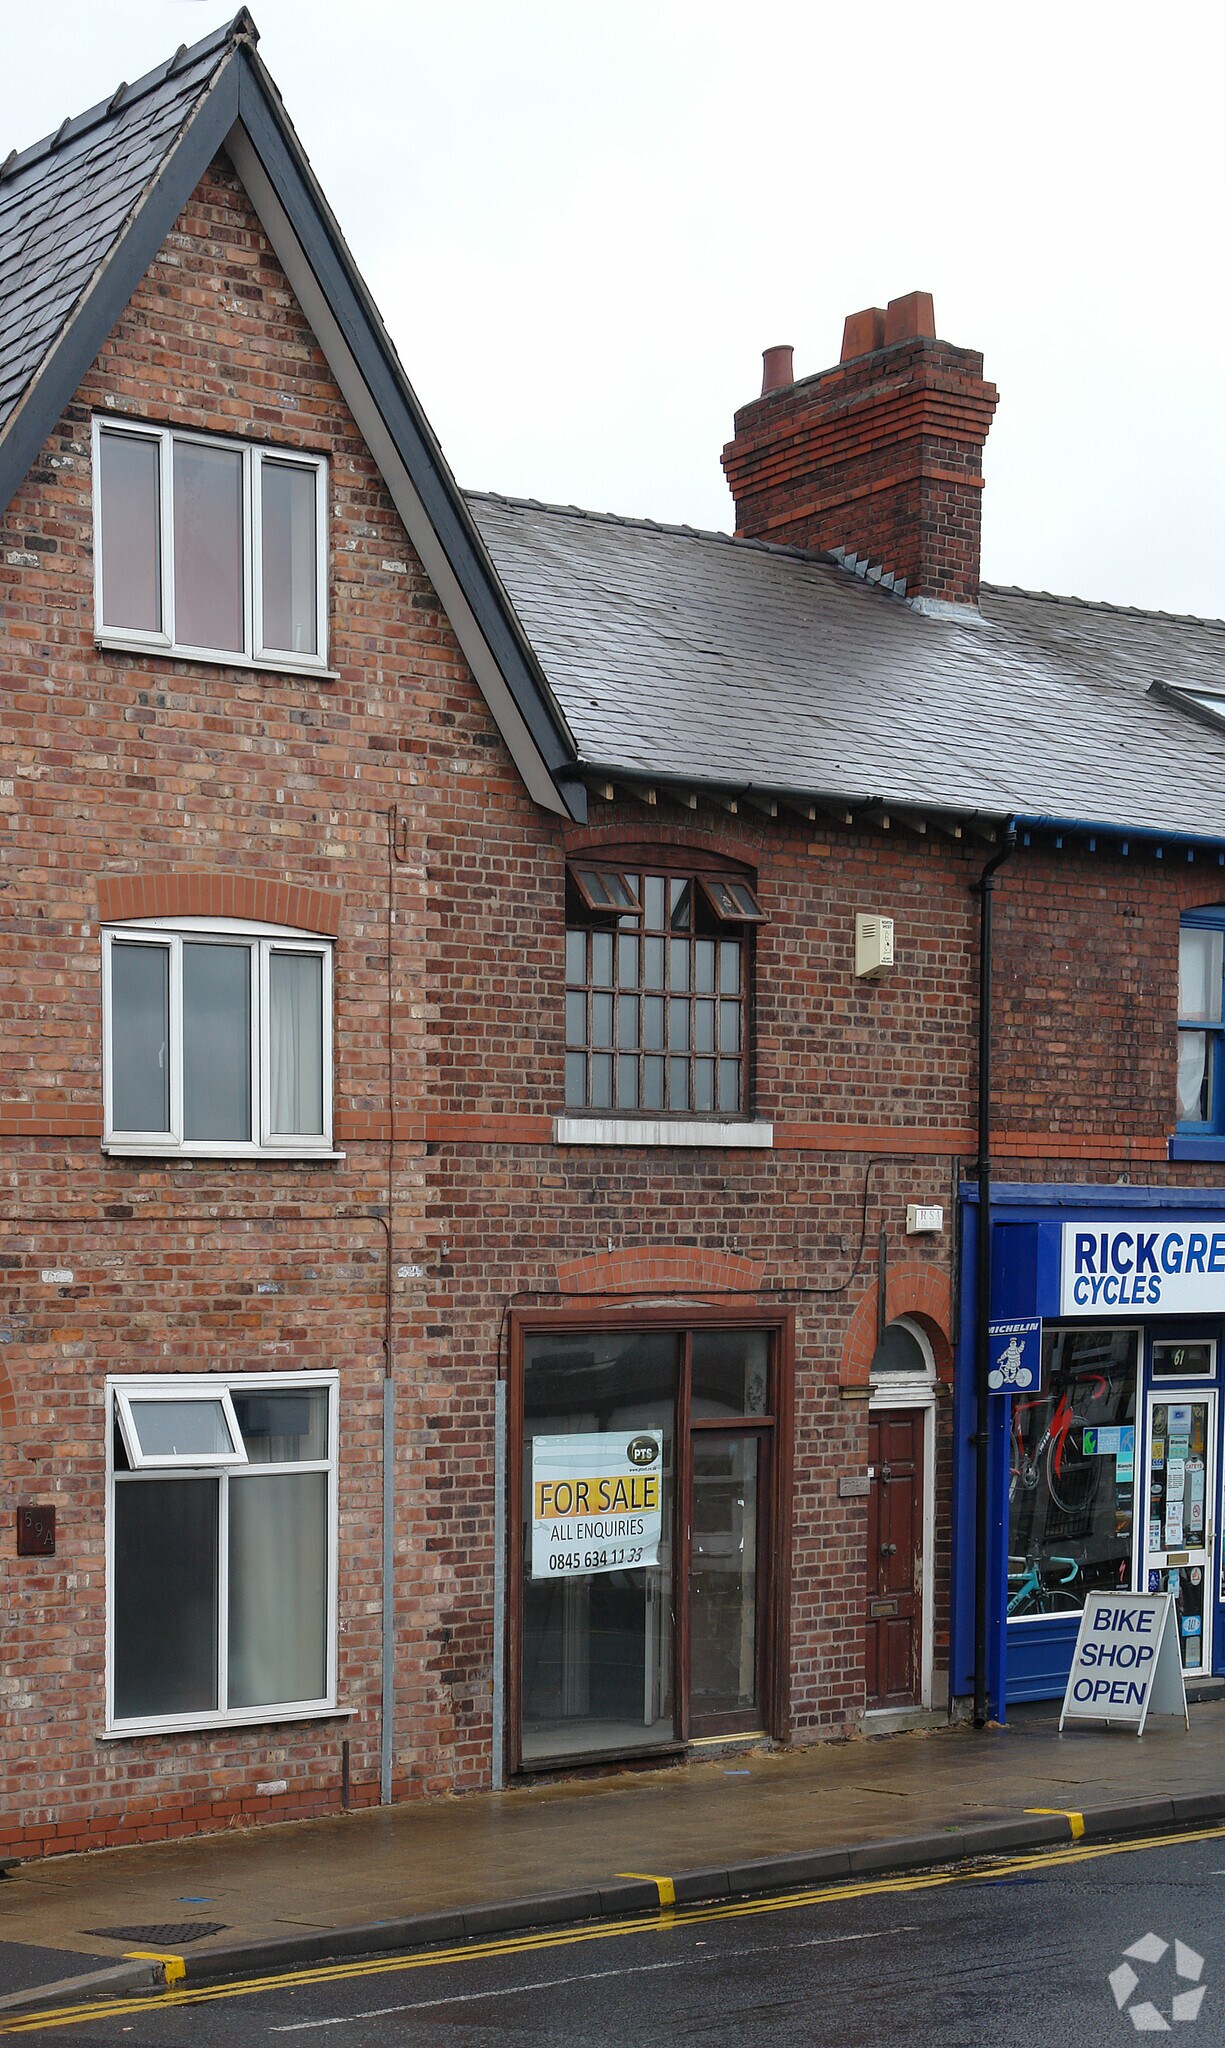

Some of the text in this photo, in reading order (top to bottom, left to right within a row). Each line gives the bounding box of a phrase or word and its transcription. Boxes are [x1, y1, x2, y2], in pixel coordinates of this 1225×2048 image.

[1074, 1275, 1162, 1306] CYCLES
[988, 1322, 1039, 1334] MICHELIN
[1174, 1349, 1185, 1366] 61
[634, 1448, 652, 1460] PTS
[540, 1476, 656, 1516] FOR SALE
[550, 1518, 644, 1542] ALL ENQUIRIES
[549, 1552, 580, 1570] 0845
[584, 1550, 608, 1567] 634
[1093, 1608, 1156, 1632] BIKE
[1080, 1643, 1154, 1668] SHOP
[1073, 1678, 1148, 1705] OPEN
